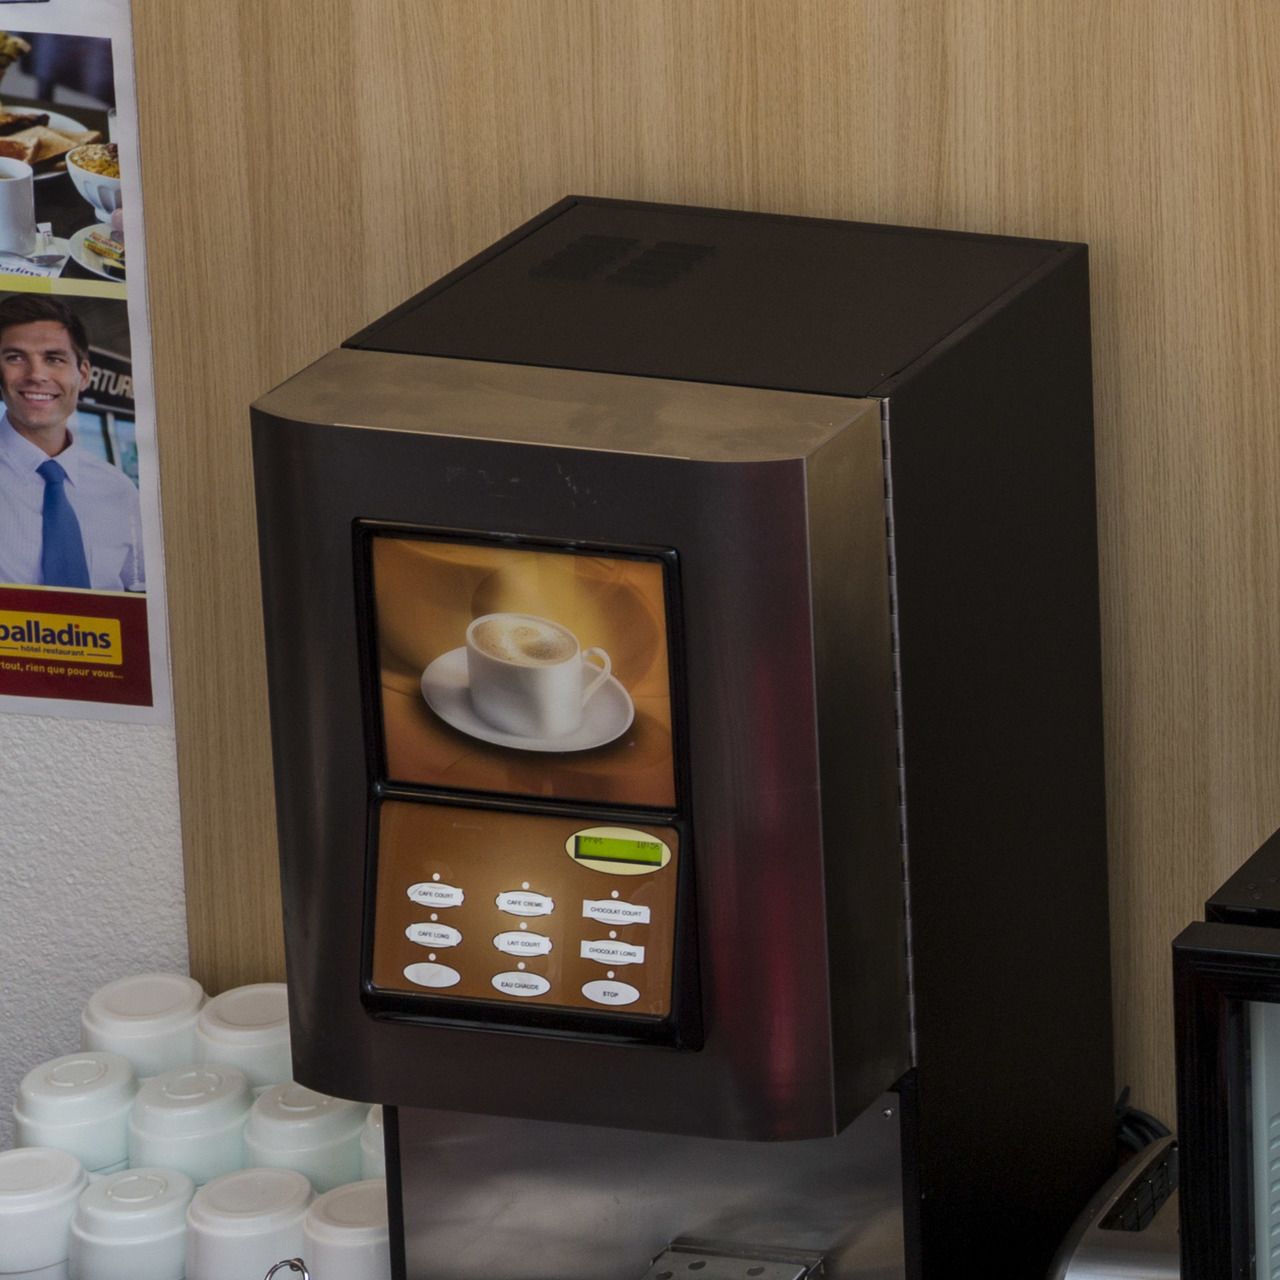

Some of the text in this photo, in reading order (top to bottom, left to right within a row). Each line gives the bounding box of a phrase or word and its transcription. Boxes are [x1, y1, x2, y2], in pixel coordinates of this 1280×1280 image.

[26, 664, 45, 673] rien
[47, 666, 65, 676] que
[67, 668, 90, 677] pour
[500, 981, 513, 989] EAU
